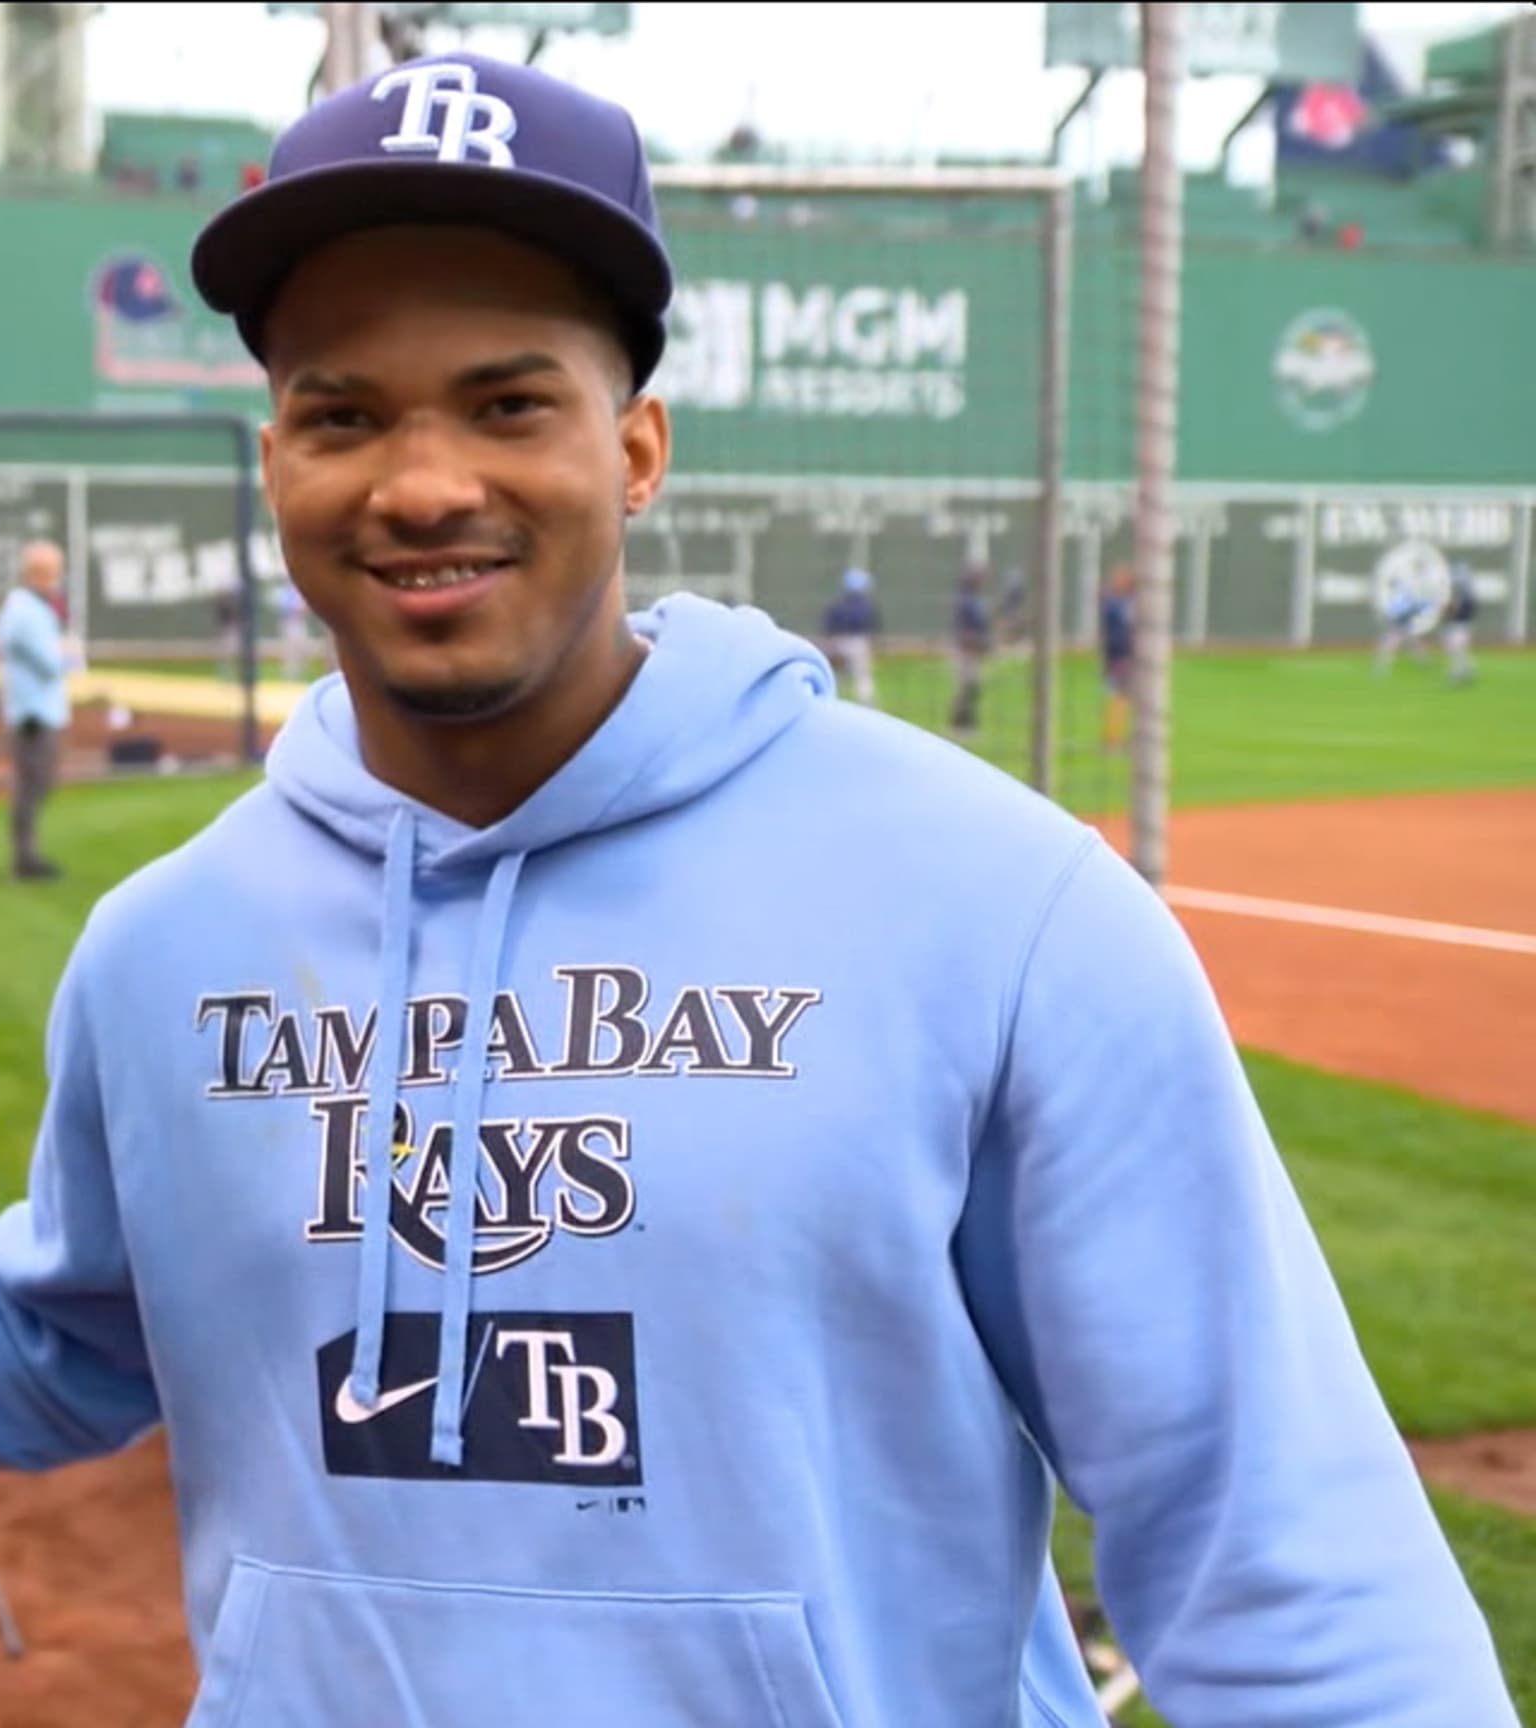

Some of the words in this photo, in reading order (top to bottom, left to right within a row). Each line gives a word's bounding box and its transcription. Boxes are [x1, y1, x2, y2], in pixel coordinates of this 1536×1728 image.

[762, 279, 968, 365] MGM
[195, 986, 547, 1100] TAMPA
[553, 964, 822, 1080] BAY
[305, 1095, 635, 1276] RAYS
[496, 1330, 627, 1467] TB
